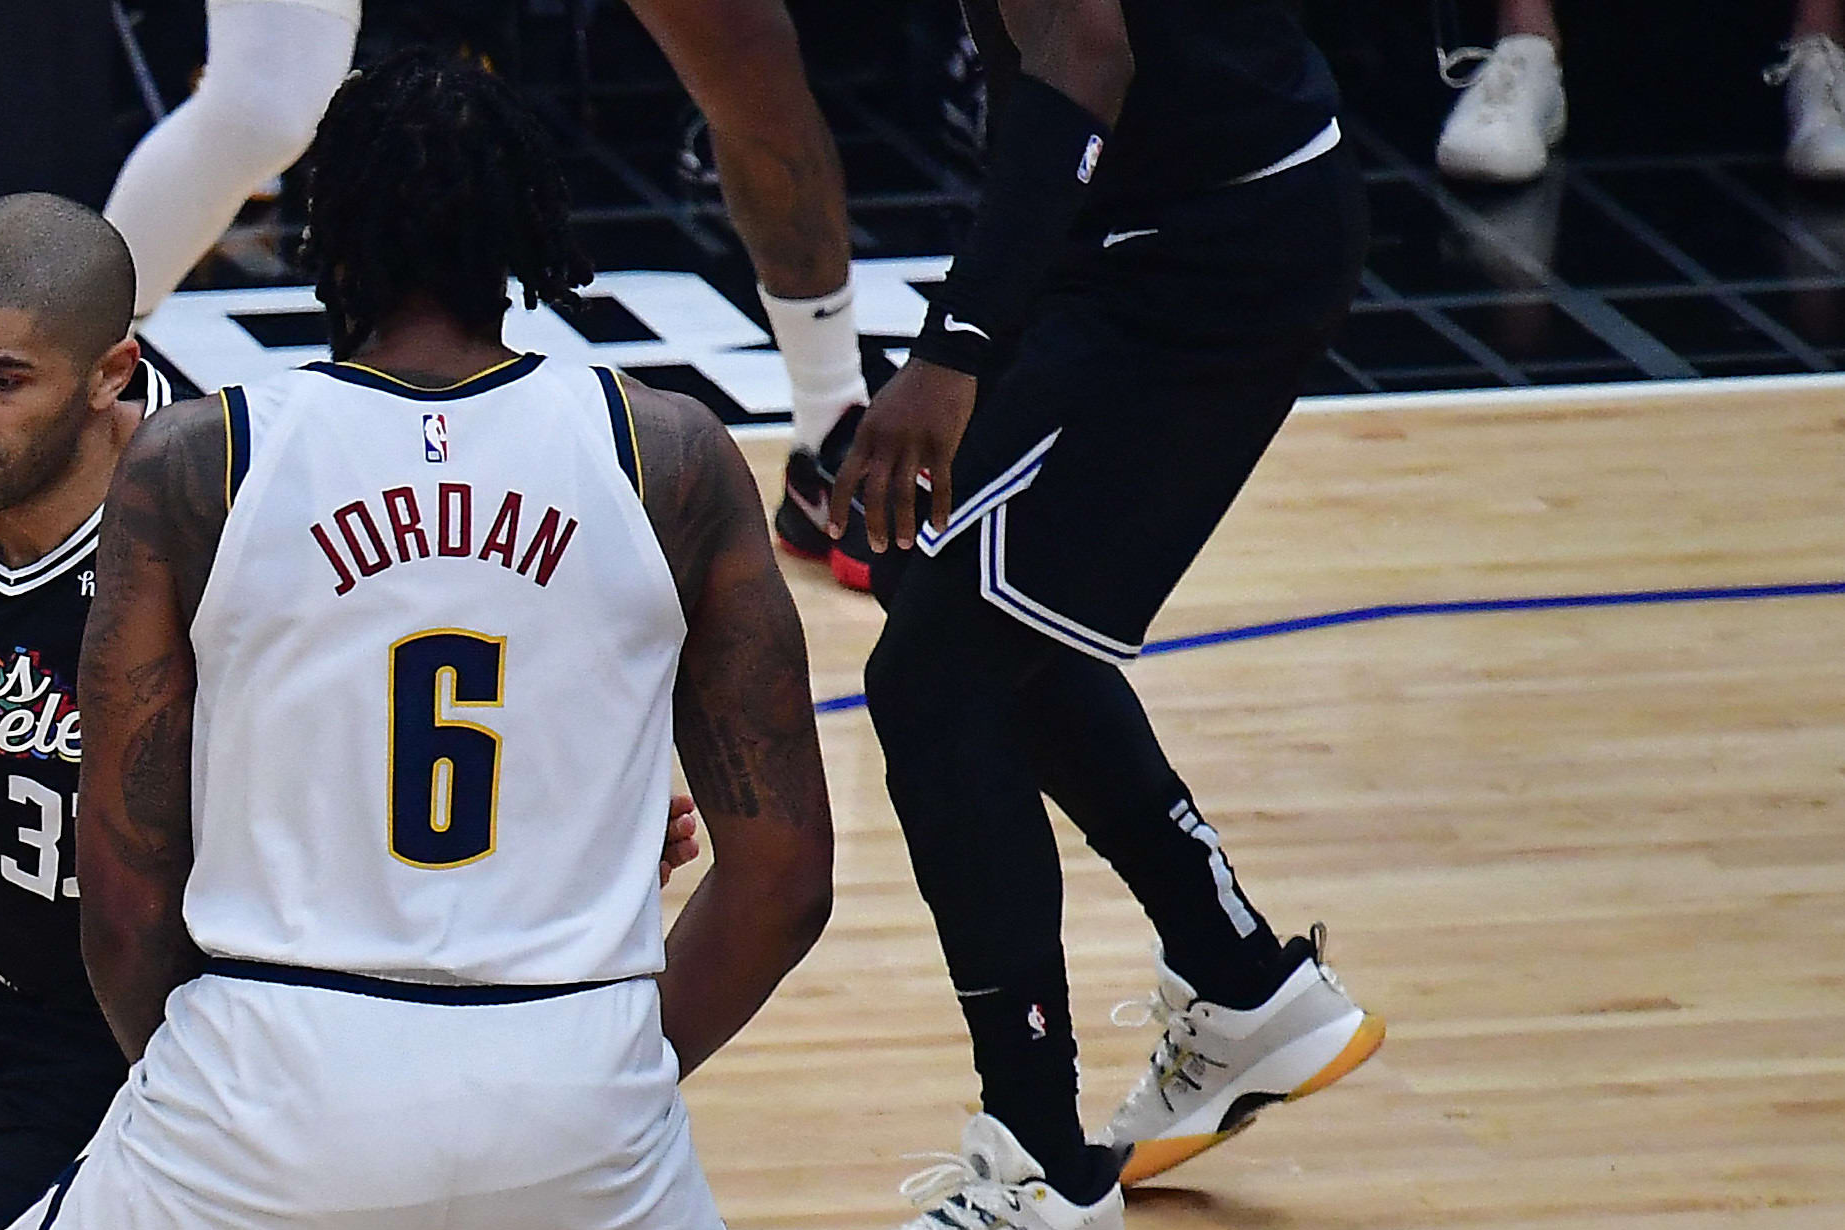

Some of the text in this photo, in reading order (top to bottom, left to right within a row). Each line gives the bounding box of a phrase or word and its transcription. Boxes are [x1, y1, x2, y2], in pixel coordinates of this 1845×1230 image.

[310, 482, 578, 596] JORDAN
[388, 627, 507, 869] 6
[0, 774, 81, 902] 3
